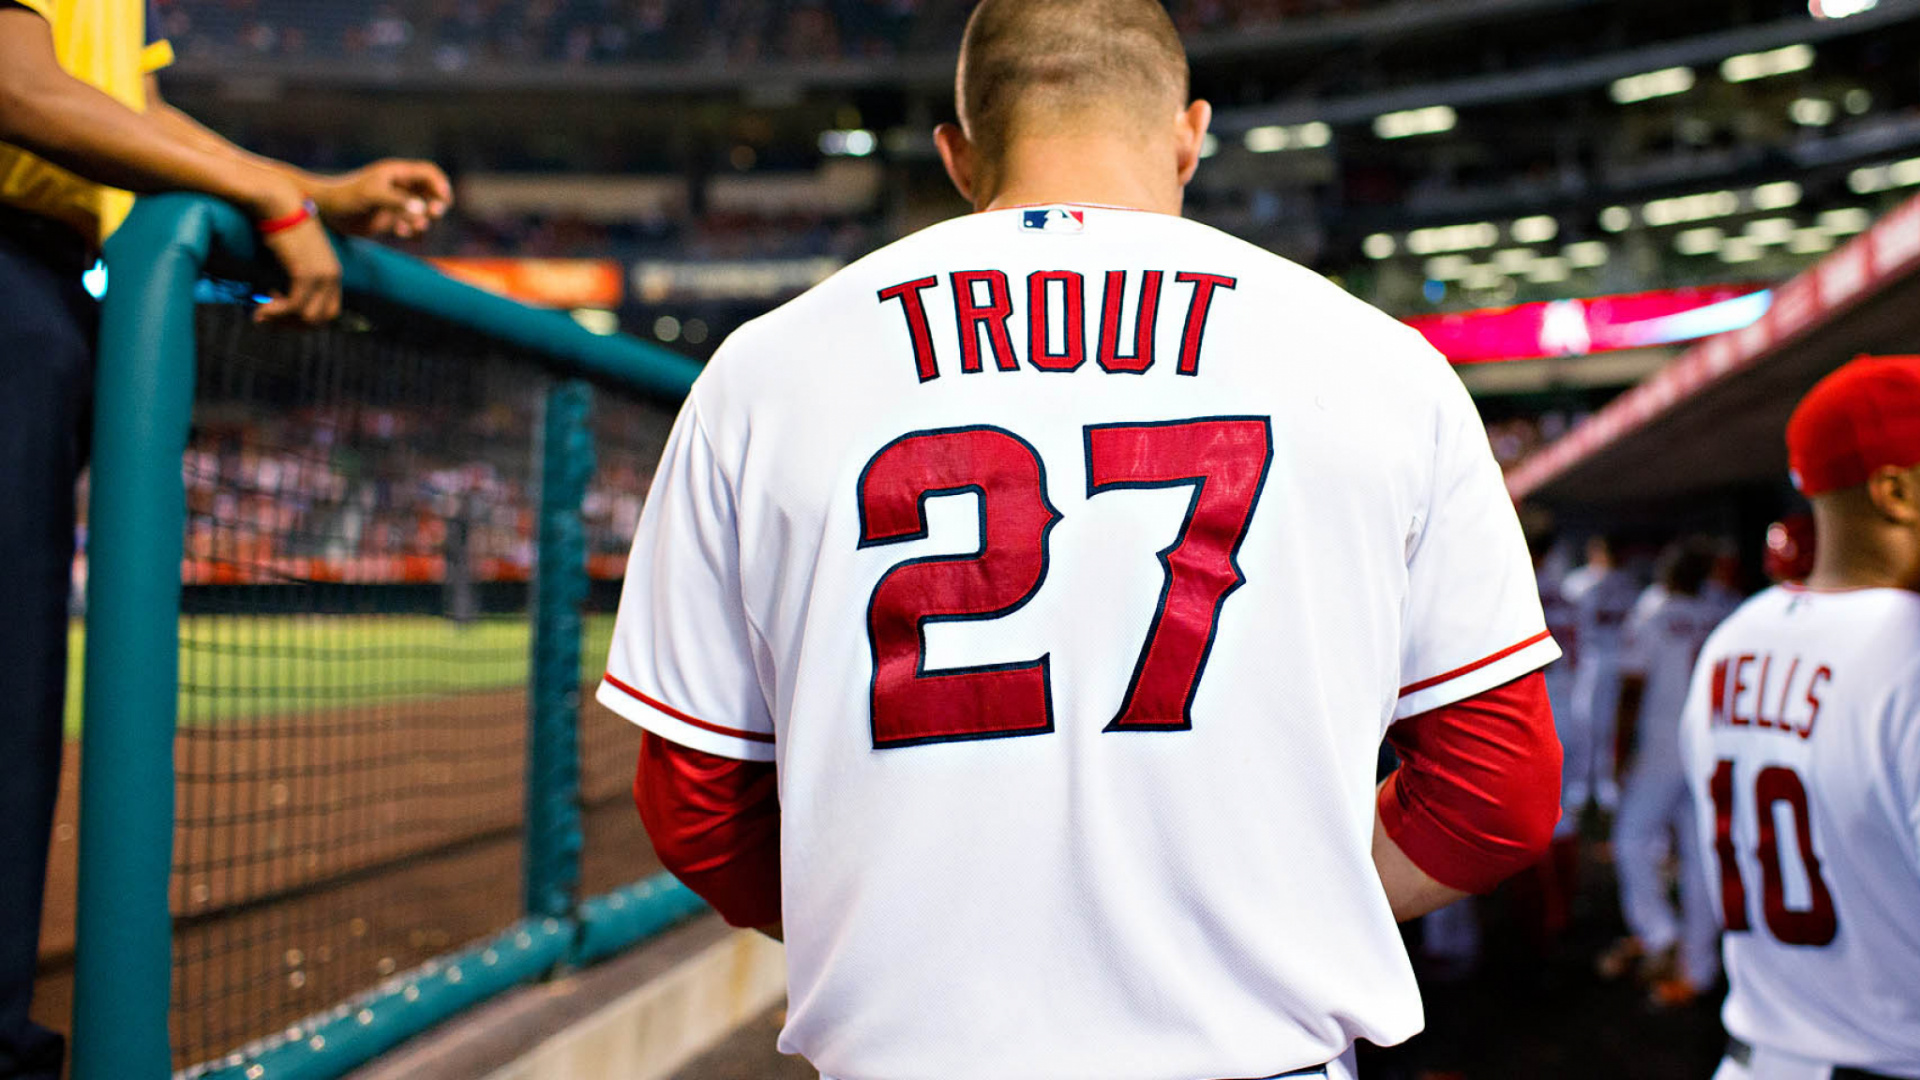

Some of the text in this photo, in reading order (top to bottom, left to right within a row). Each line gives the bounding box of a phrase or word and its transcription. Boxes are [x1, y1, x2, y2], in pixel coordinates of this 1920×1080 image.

[877, 269, 1238, 384] TROUT
[856, 415, 1274, 750] 27
[1709, 653, 1831, 739] WELLS
[1710, 758, 1837, 946] 10
